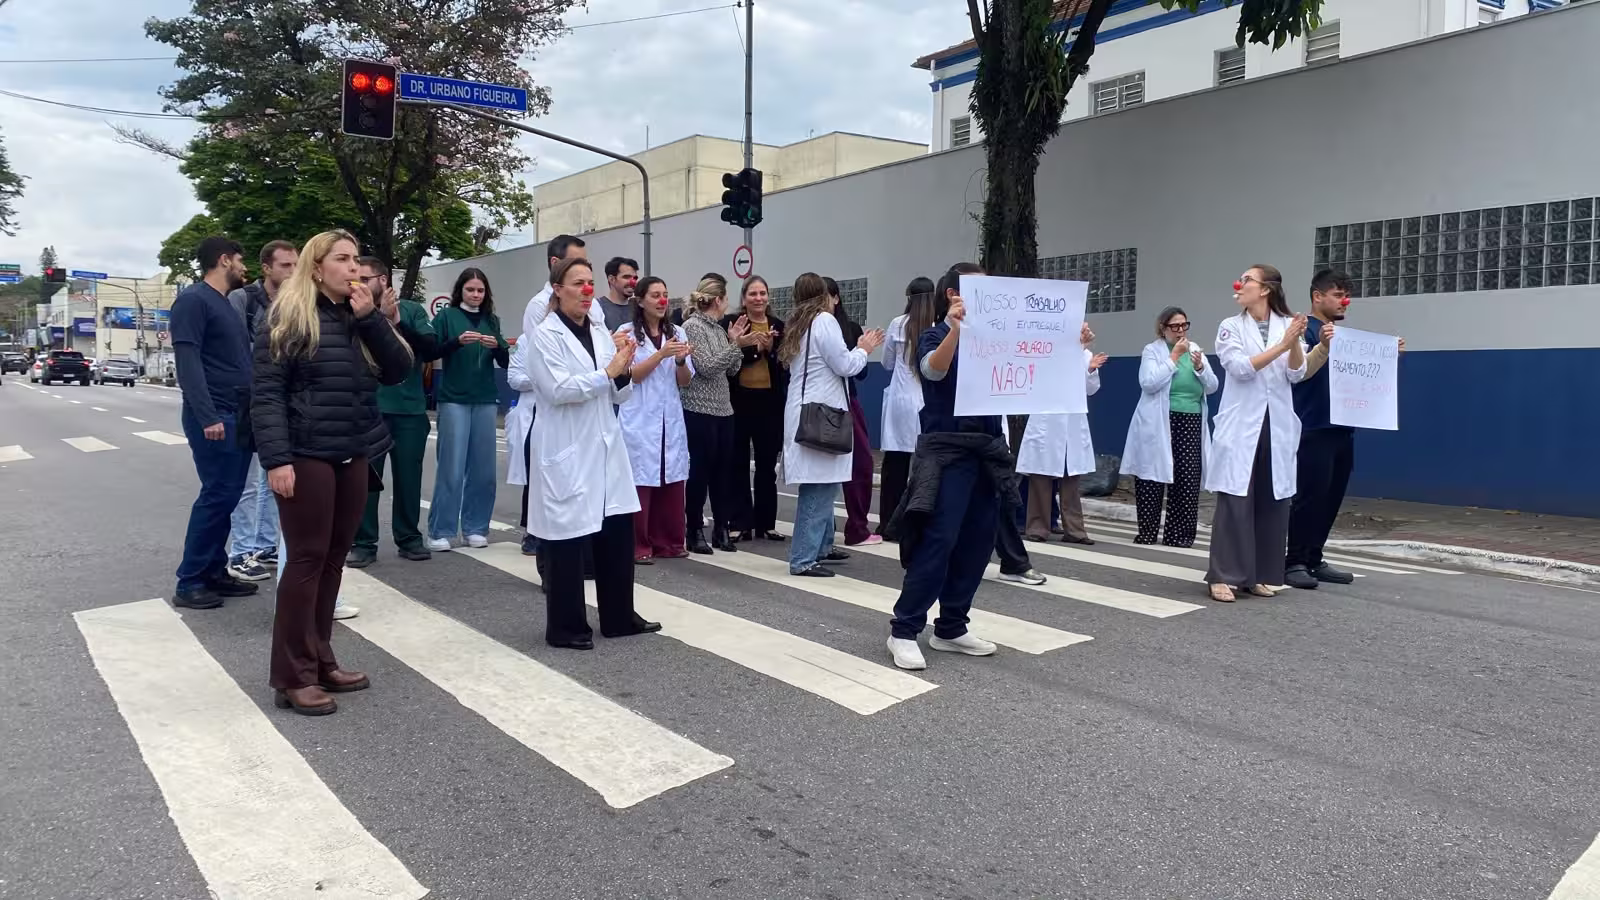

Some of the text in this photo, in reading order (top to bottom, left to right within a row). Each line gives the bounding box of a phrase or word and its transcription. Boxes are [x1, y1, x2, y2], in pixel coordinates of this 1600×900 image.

[410, 80, 518, 105] DR. URBANO FIGUEIRA
[975, 288, 1066, 314] NOSSO TRABALHO
[991, 361, 1034, 391] NÃO!
